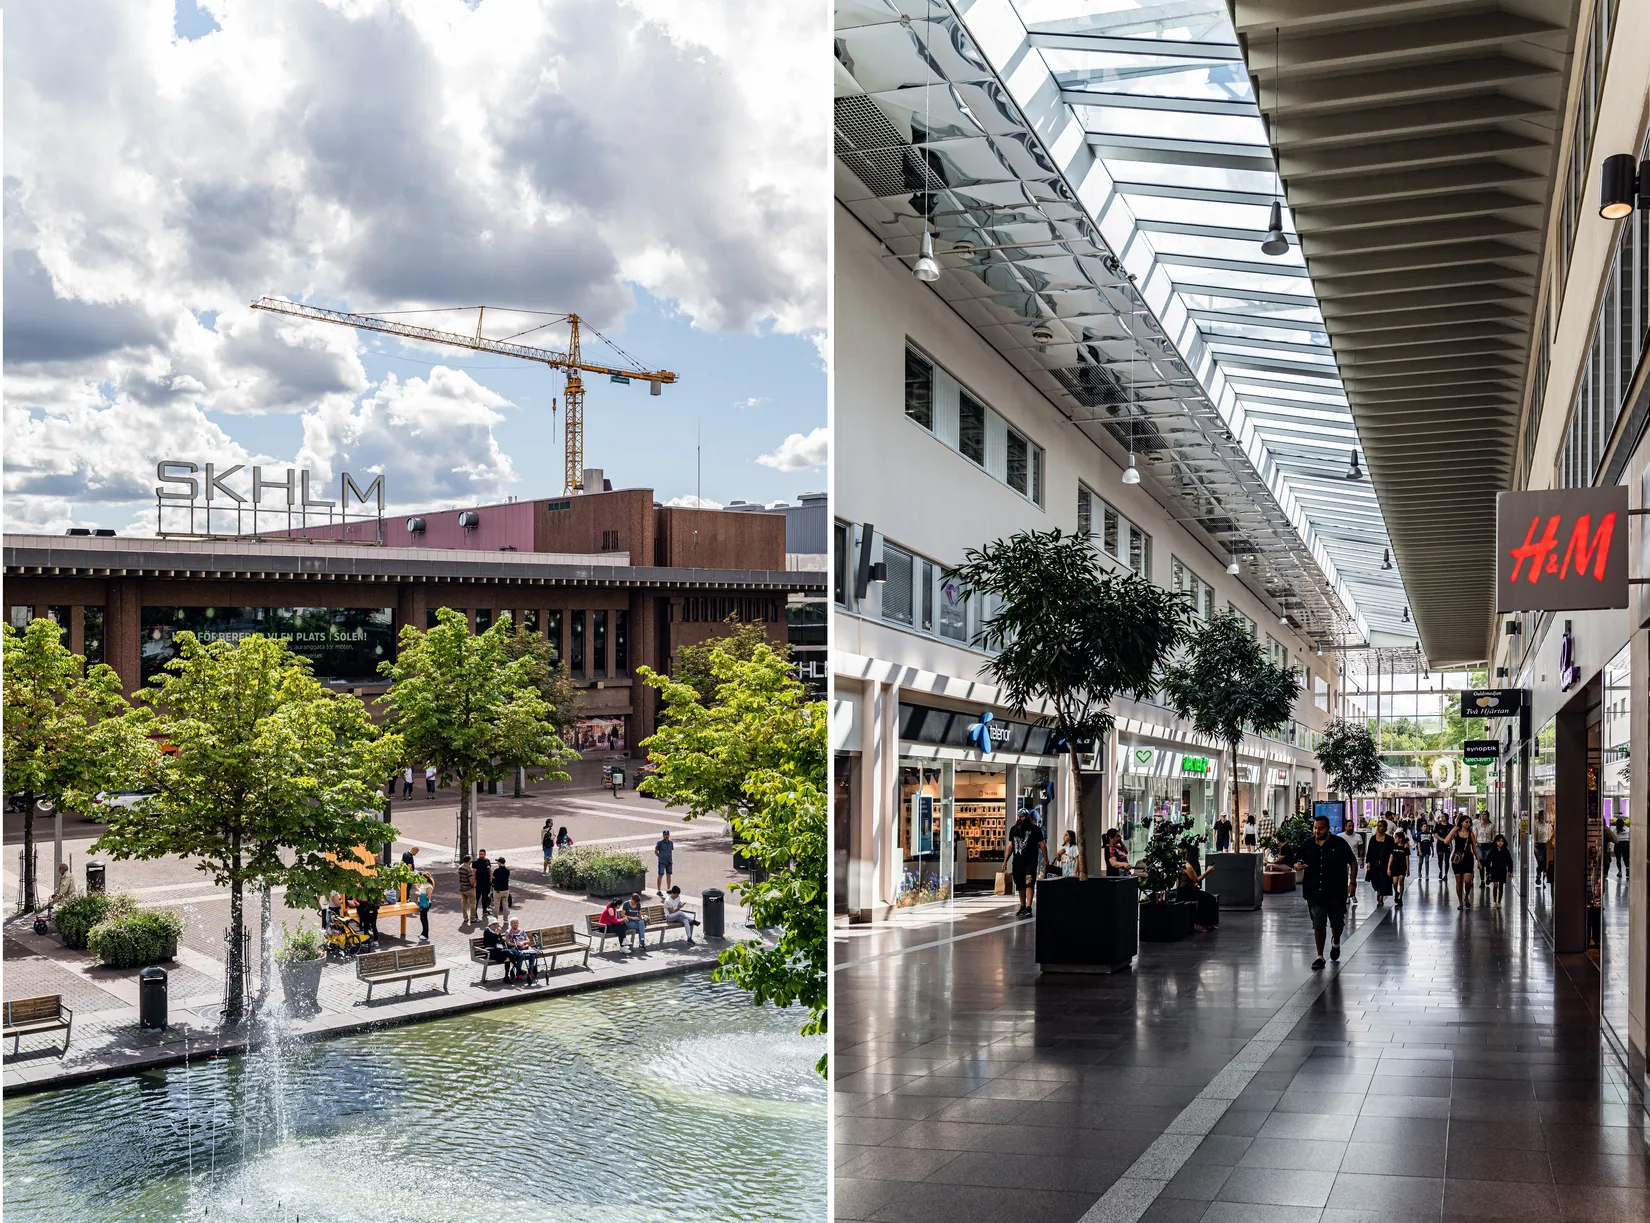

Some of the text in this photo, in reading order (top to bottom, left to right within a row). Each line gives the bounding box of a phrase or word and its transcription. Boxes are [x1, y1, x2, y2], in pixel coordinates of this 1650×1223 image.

[156, 460, 385, 510] SKHLM
[1510, 511, 1617, 584] H&M
[197, 630, 264, 641] FÖRBERED
[296, 632, 326, 641] PLATS
[334, 632, 367, 641] SOLEN!
[989, 724, 1011, 741] telenor
[1466, 745, 1497, 753] synoptik
